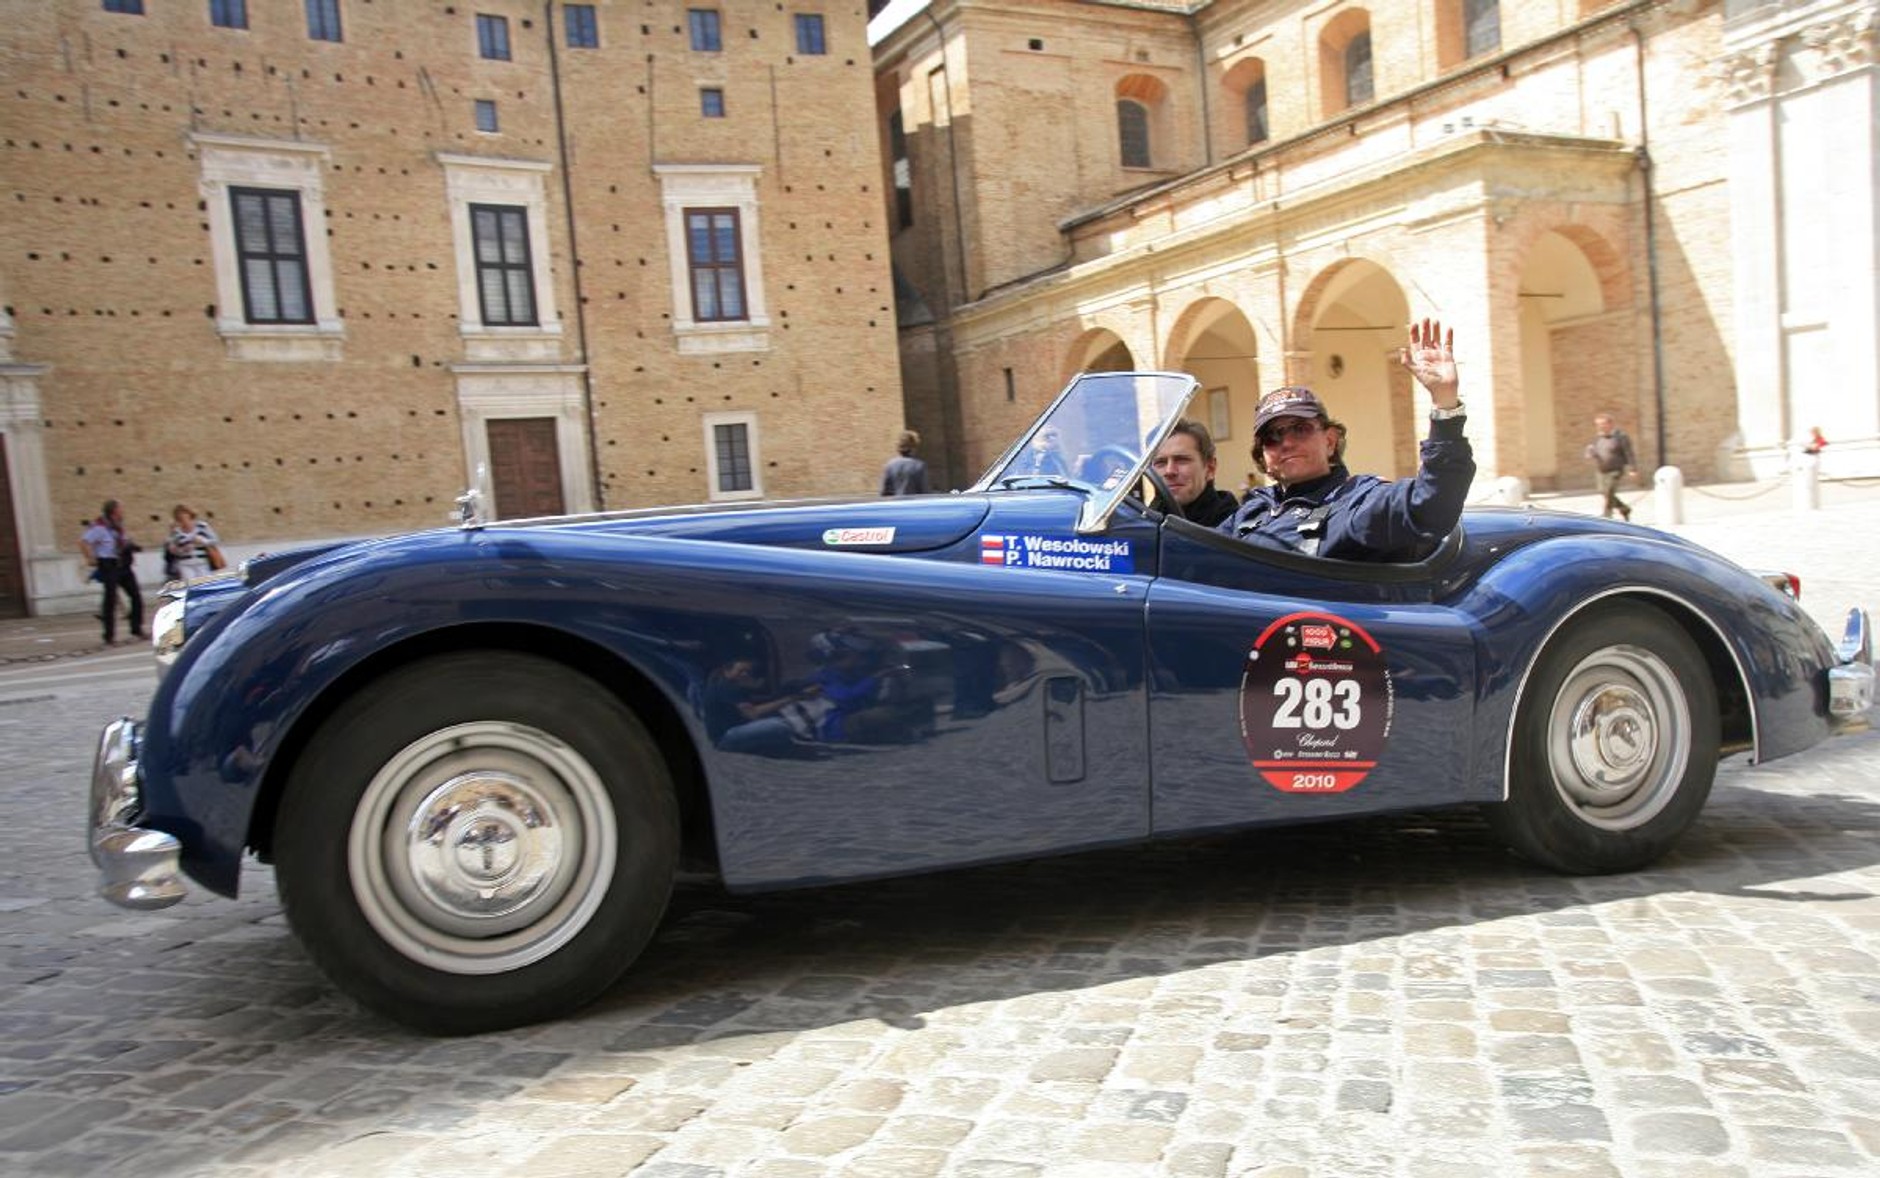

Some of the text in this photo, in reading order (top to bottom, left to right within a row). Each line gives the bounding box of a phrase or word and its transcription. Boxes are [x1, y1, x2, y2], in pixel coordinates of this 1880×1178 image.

[841, 530, 889, 542] Castrol
[1004, 535, 1022, 550] T.
[1006, 551, 1111, 570] P. Nawrocki
[1272, 677, 1362, 730] 283
[1292, 774, 1336, 788] 2010
